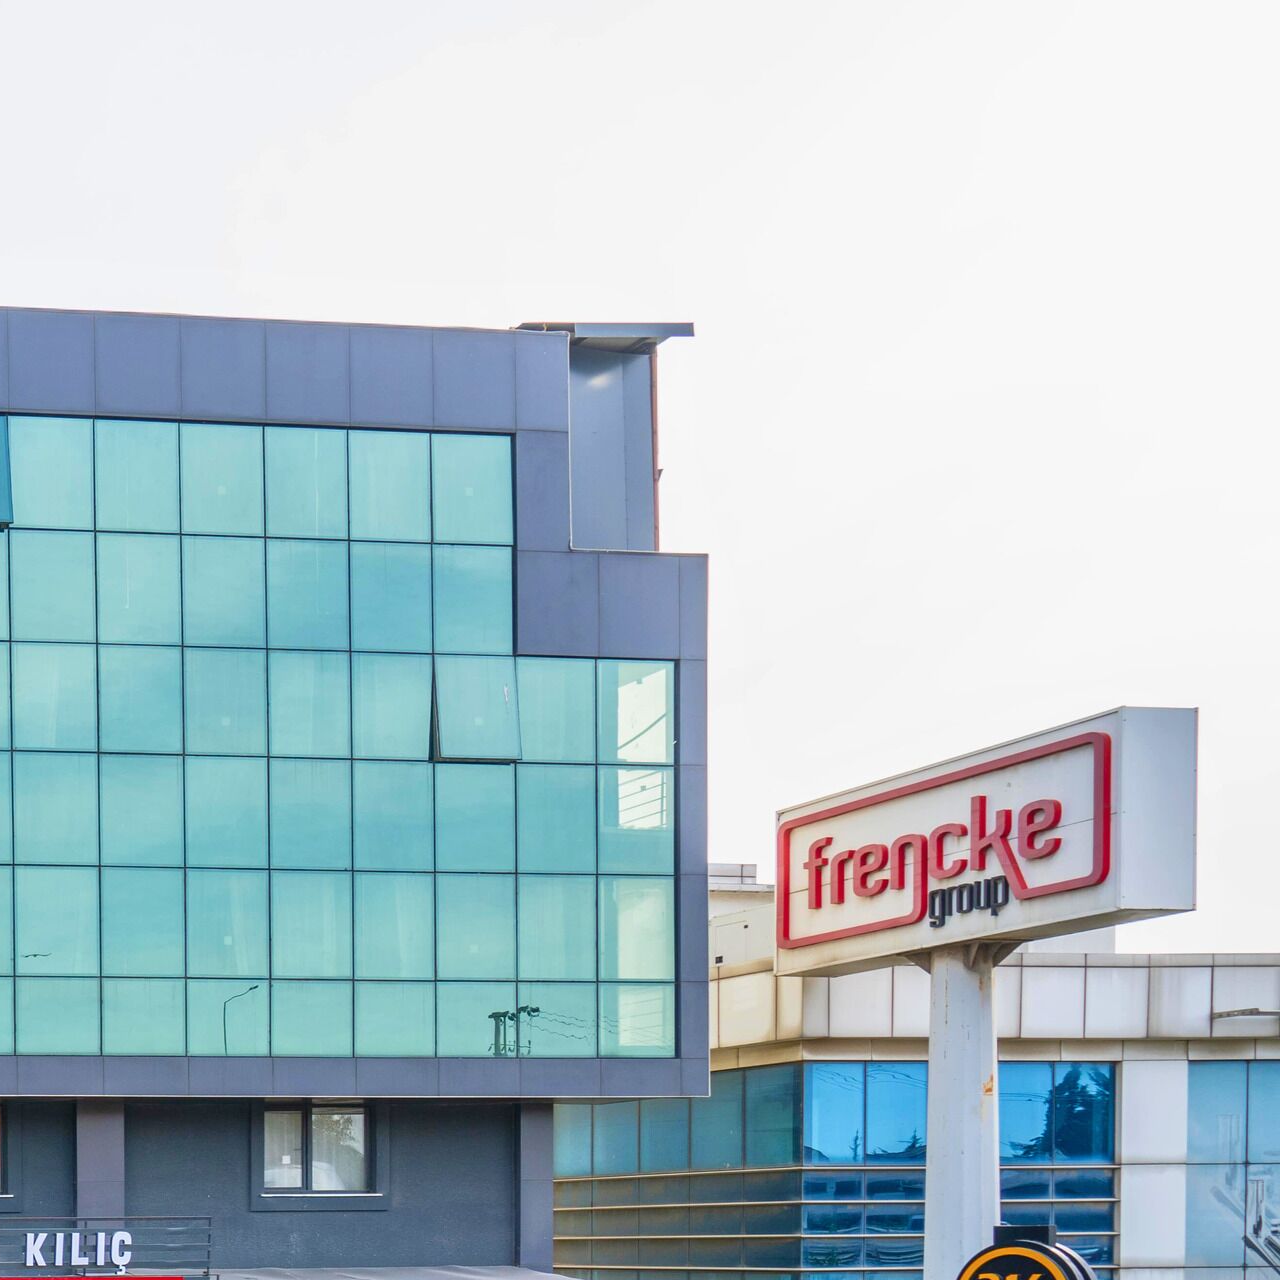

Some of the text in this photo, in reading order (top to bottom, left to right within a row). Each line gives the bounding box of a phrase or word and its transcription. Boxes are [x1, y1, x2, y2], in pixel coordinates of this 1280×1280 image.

[803, 796, 1063, 910] frencke
[928, 875, 1009, 928] group
[25, 1231, 132, 1275] KILIÇ
